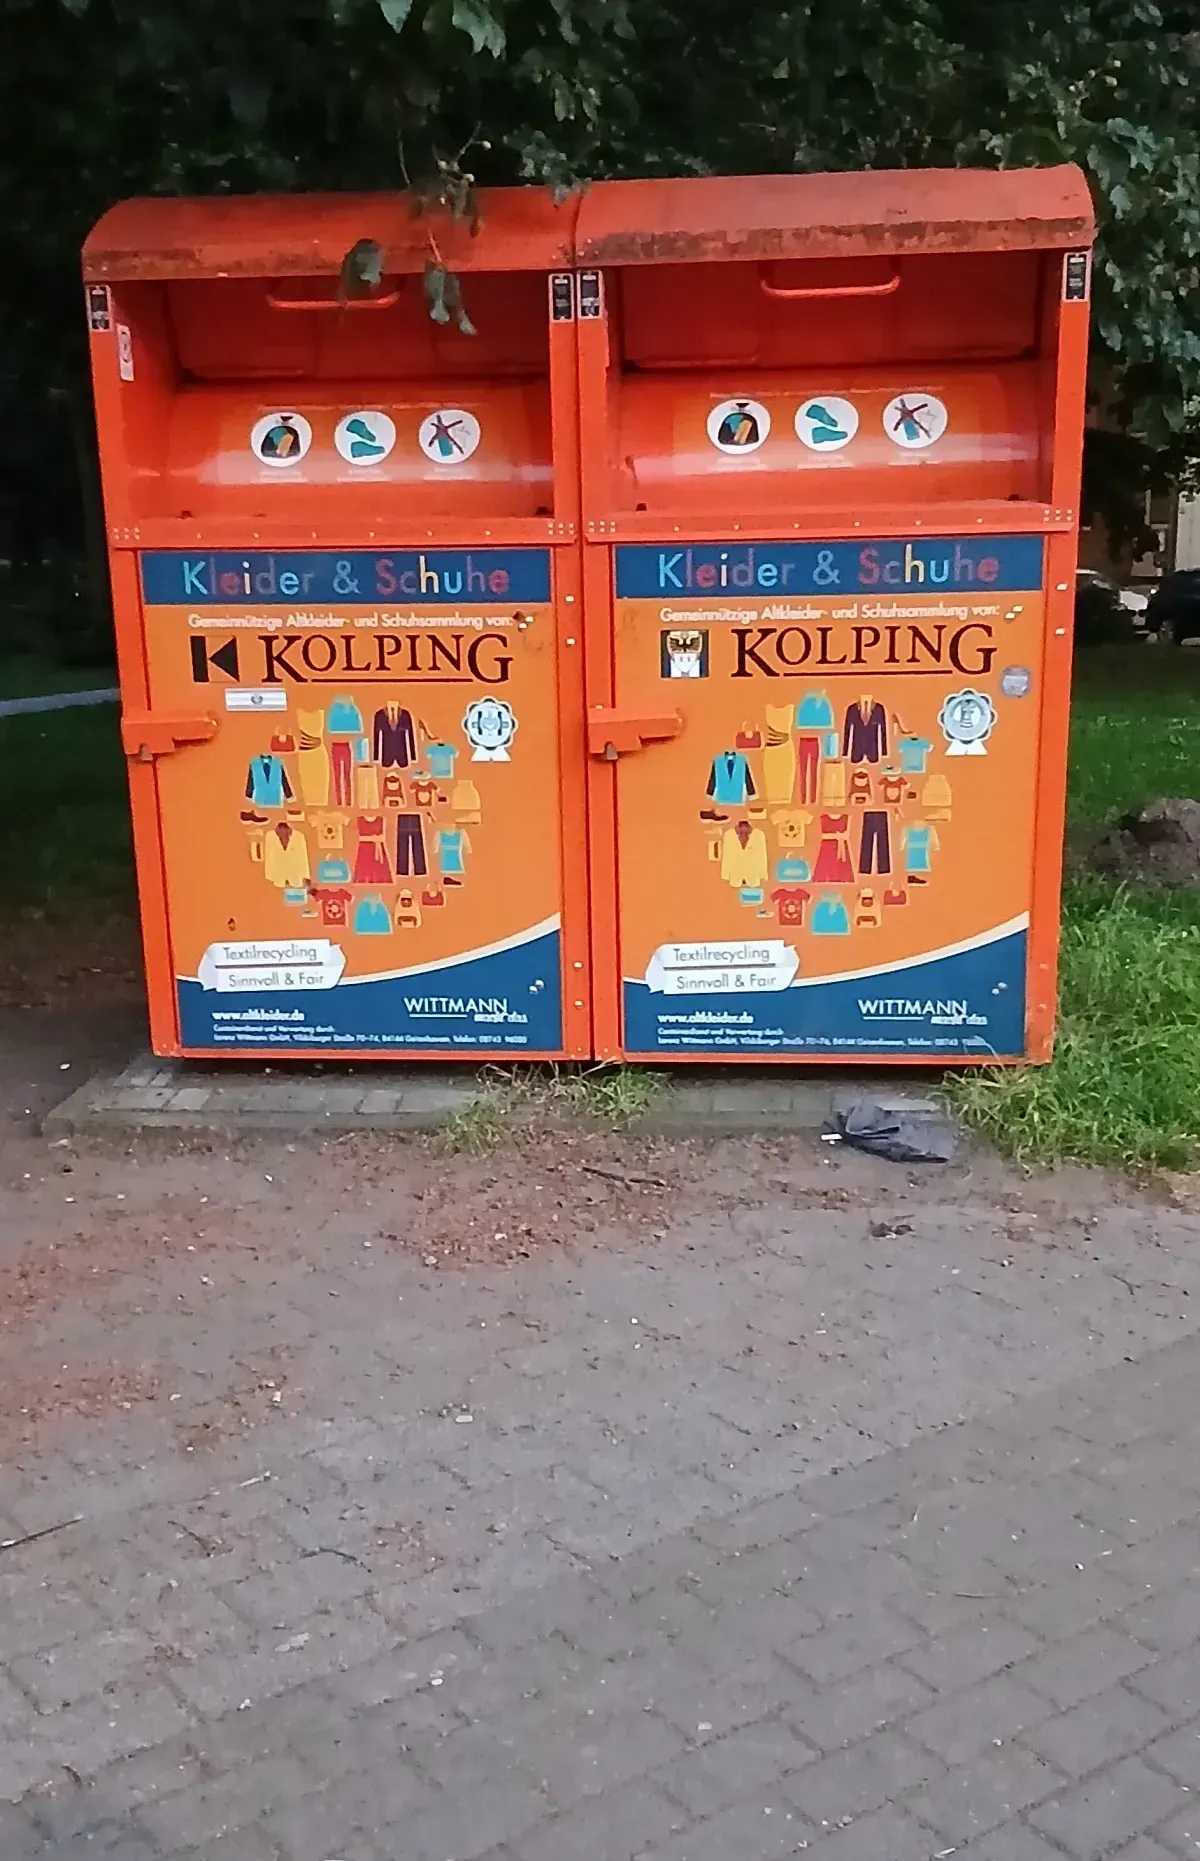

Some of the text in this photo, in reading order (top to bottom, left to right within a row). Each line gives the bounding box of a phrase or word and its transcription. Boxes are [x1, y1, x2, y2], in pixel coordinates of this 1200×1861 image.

[658, 543, 1000, 589] Kleider & Schuhe
[182, 555, 511, 597] Kleider & Schuhe
[831, 602, 858, 619] und
[861, 601, 968, 621] Schuhsammlung
[354, 611, 378, 628] und
[381, 611, 483, 631] Schuhsammlung
[258, 632, 513, 684] KOLPING
[730, 622, 998, 679] KOLPING
[223, 943, 317, 961] Textilrecycling
[673, 944, 770, 963] Textilrecycling
[228, 971, 325, 987] Sinnvoll & Fair
[676, 972, 777, 990] Sinnvoll & Fair
[403, 997, 508, 1014] WITTMANN
[858, 999, 968, 1016] WITTMANN
